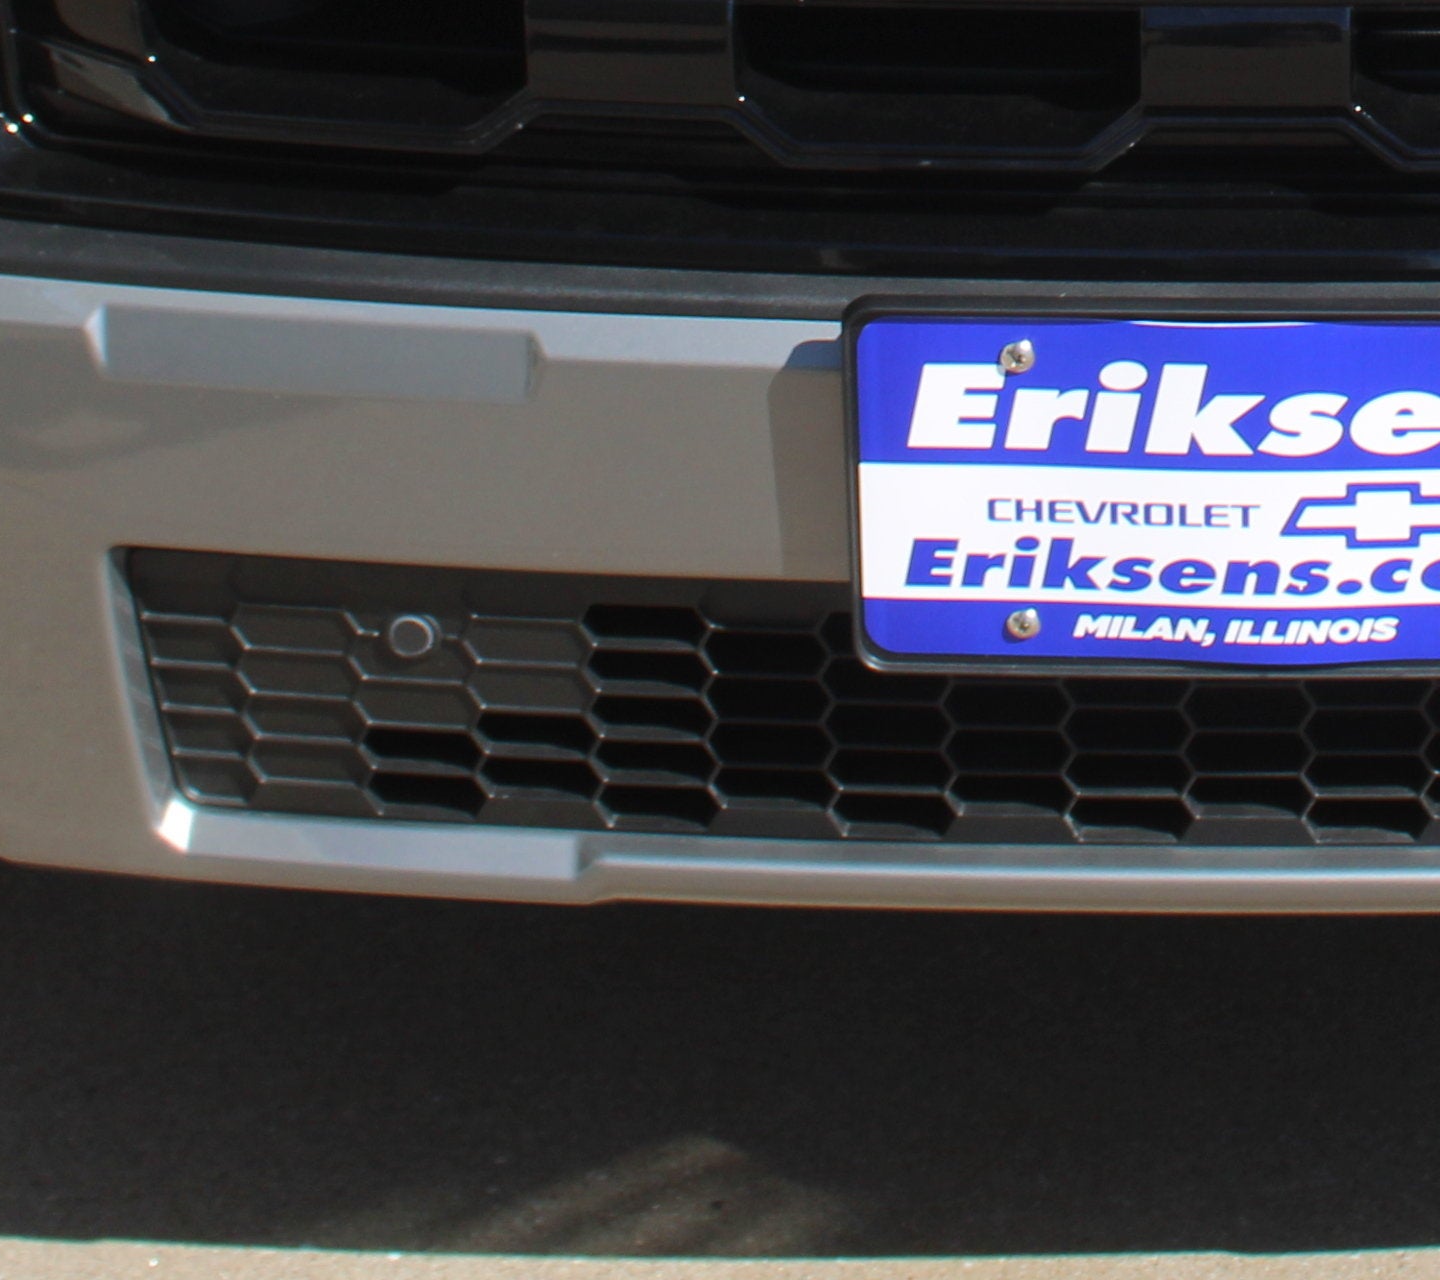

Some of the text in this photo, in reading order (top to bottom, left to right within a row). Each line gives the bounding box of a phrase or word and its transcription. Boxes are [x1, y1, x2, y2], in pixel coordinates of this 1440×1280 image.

[986, 497, 1261, 529] CHEVROLET
[1073, 614, 1400, 647] MILAN, ILLINOIS
